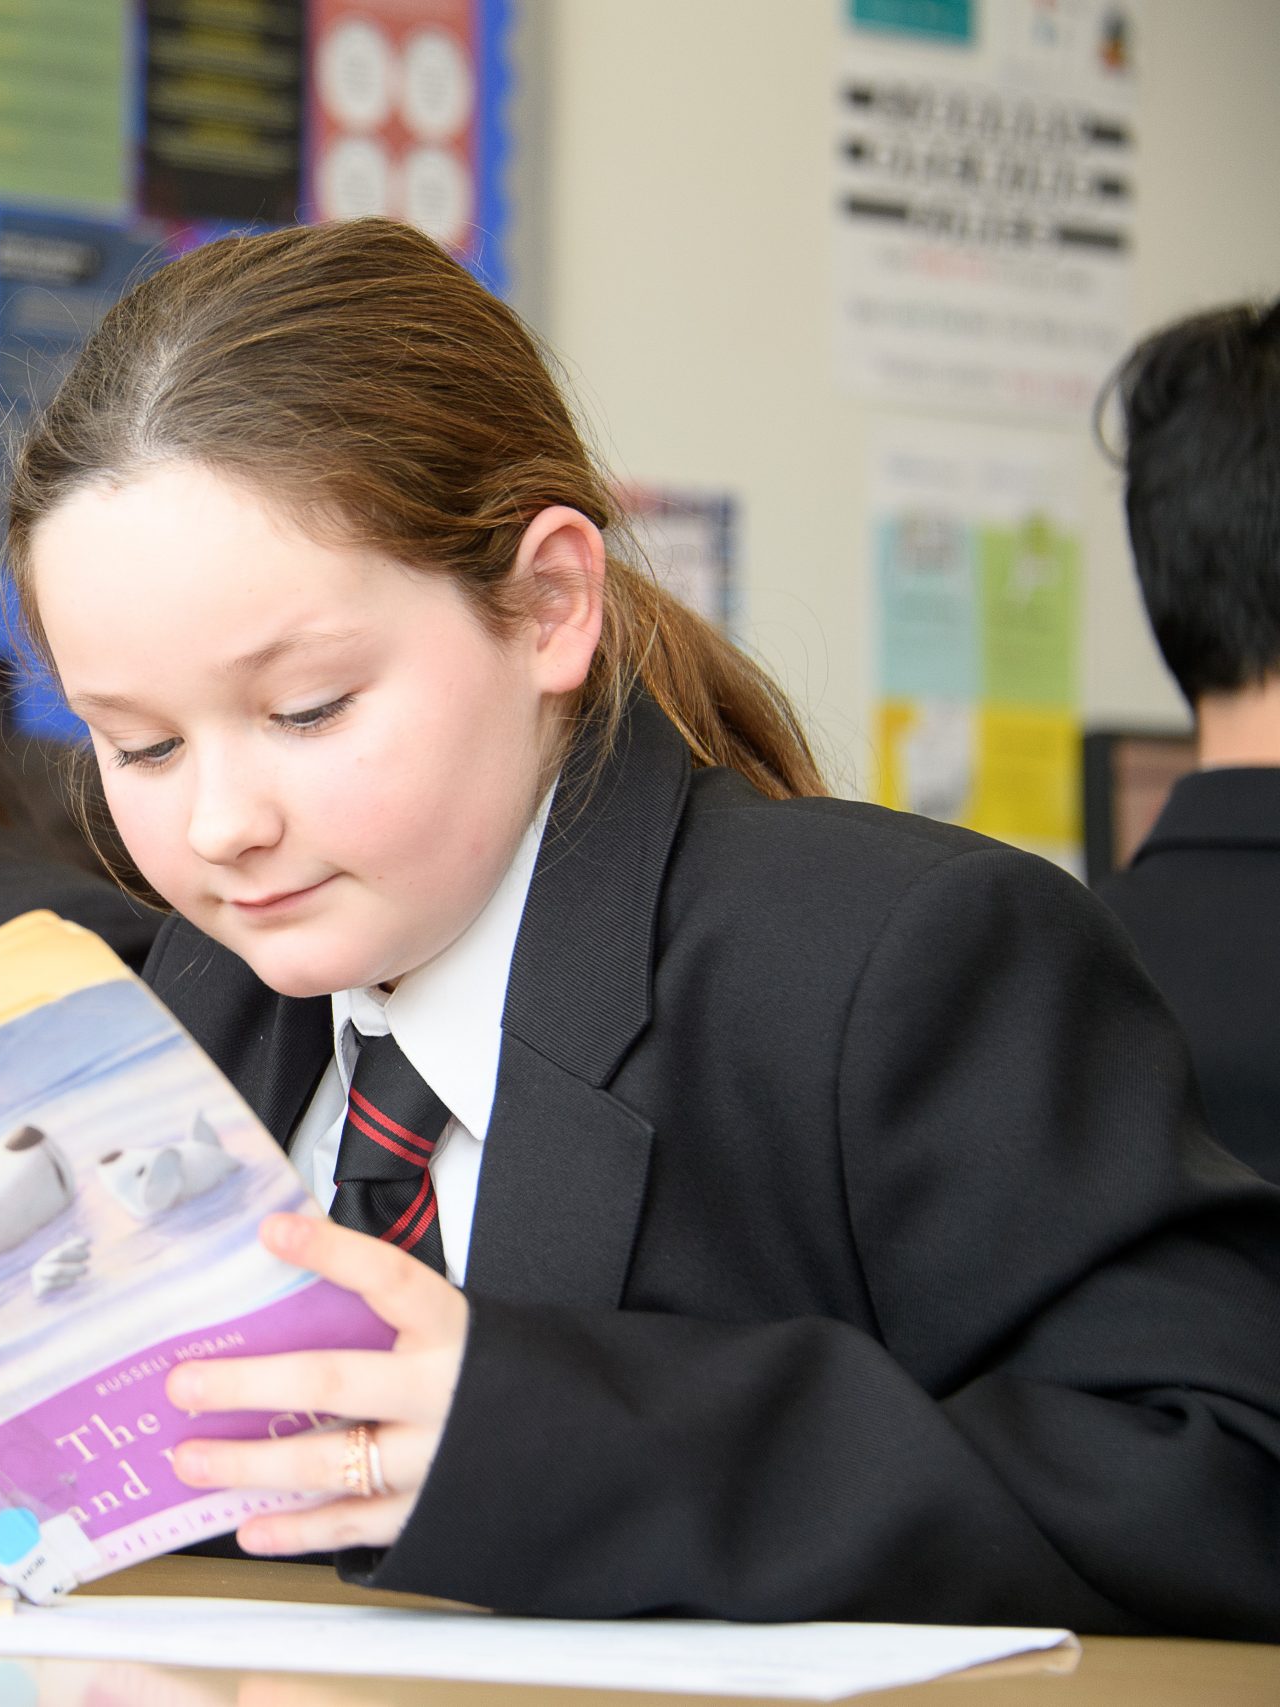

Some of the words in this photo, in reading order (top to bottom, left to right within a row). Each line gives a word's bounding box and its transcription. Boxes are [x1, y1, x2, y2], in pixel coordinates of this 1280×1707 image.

[94, 1356, 171, 1397] RUSSELL
[174, 1331, 246, 1362] HOBAN
[55, 1411, 161, 1463] The
[107, 1524, 179, 1562] uffin
